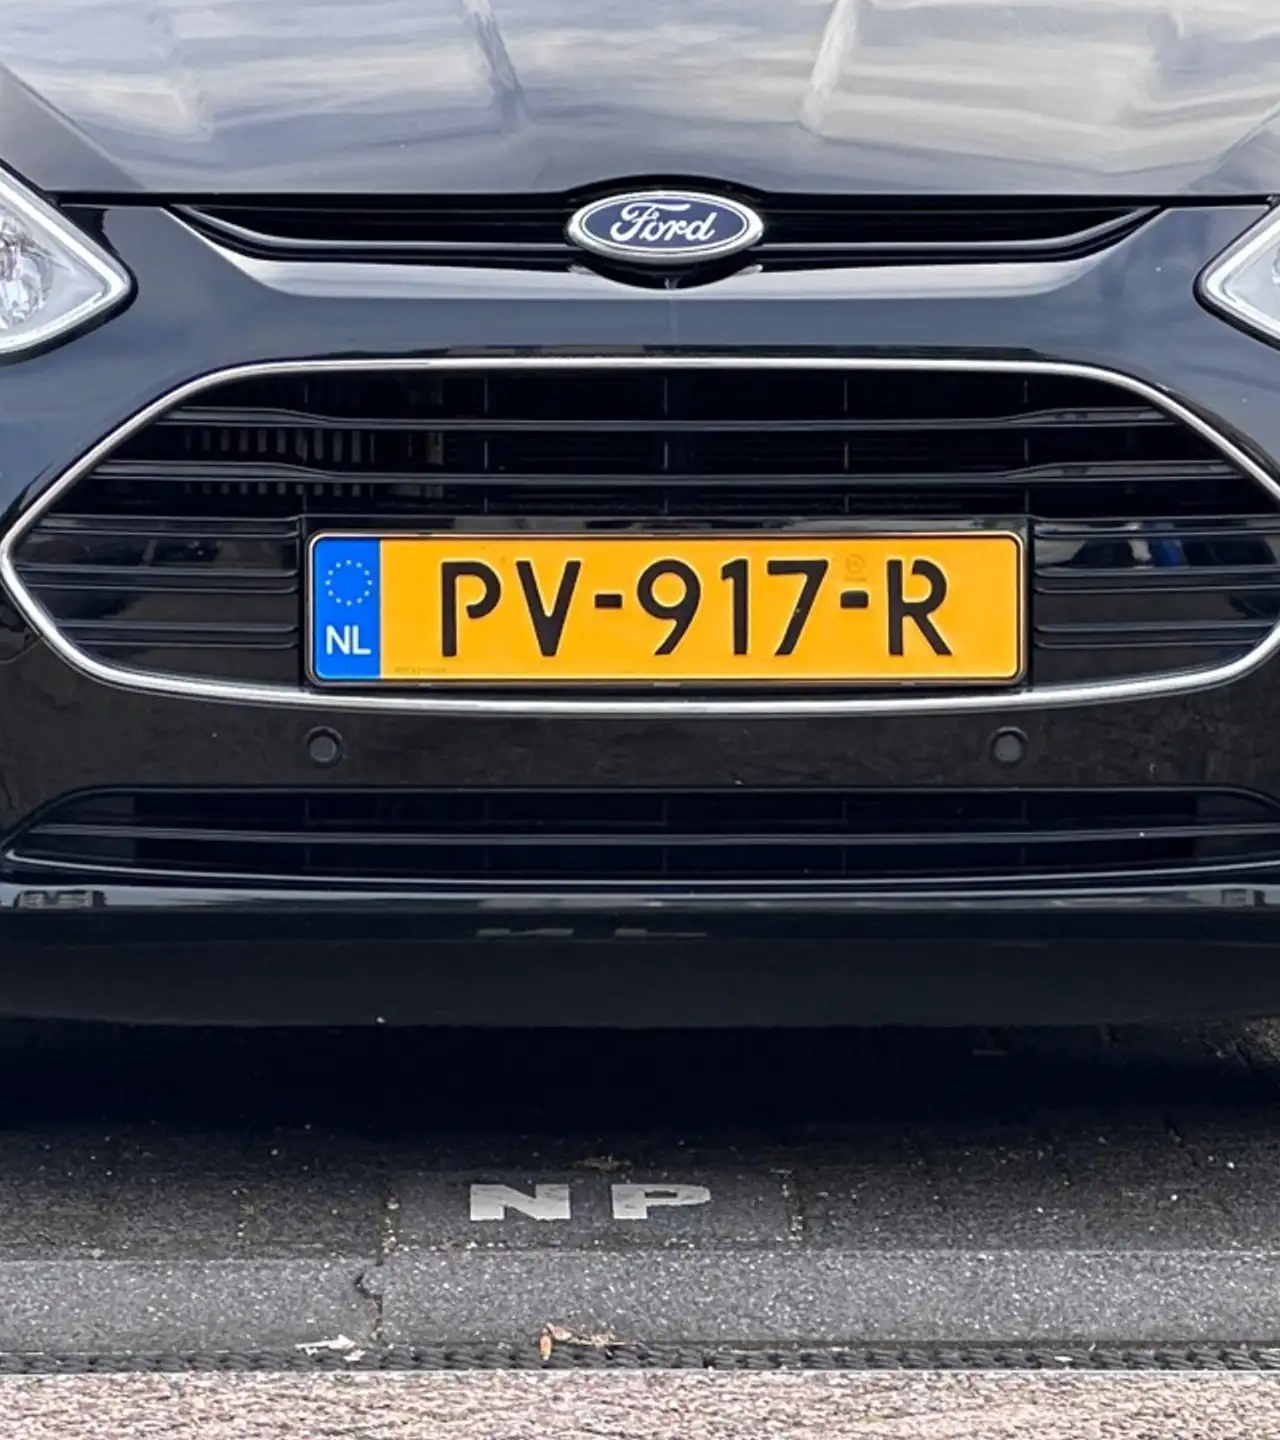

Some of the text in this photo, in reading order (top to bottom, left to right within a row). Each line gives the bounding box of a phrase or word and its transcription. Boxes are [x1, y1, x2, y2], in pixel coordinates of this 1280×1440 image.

[610, 202, 717, 242] Ford
[440, 559, 952, 657] PV-917-R
[326, 625, 371, 655] NL
